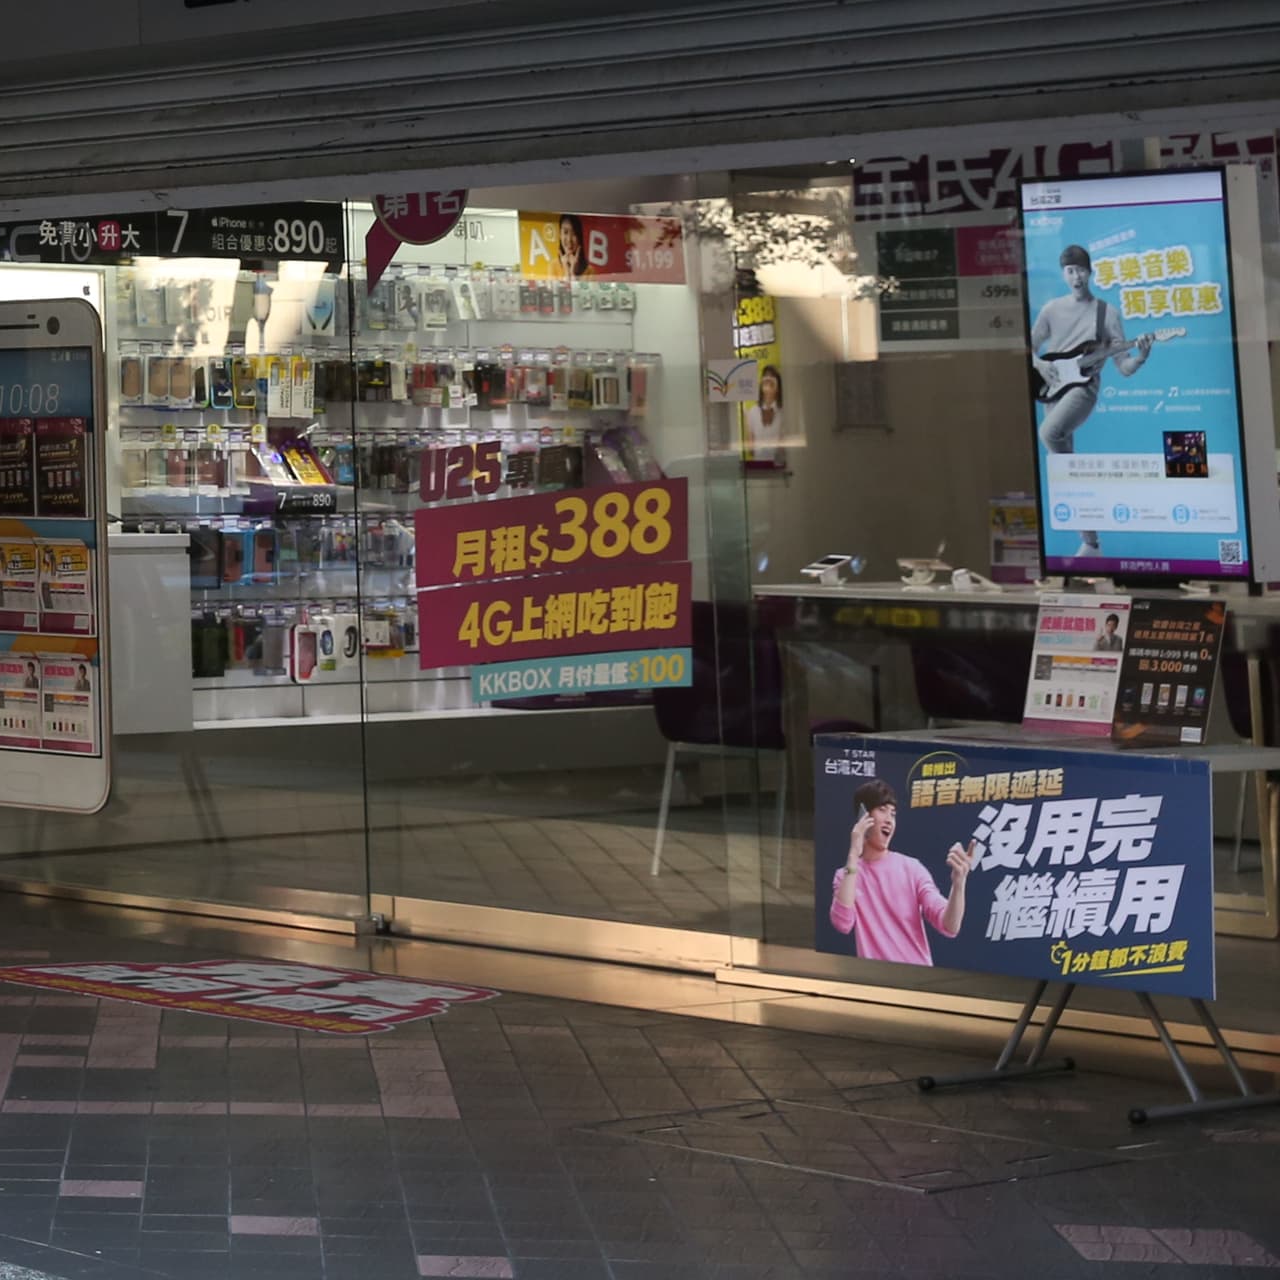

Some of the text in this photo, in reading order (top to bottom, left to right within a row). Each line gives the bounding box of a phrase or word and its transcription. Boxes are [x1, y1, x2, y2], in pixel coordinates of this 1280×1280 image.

[39, 219, 140, 251] 免費小升大
[166, 210, 189, 253] 7
[528, 229, 550, 266] A
[588, 231, 609, 267] B
[1094, 250, 1192, 289] 享樂音樂
[1122, 286, 1222, 319] 獨享優惠
[419, 441, 501, 502] U25
[453, 487, 672, 577] 月租$388
[458, 582, 679, 649] 4G上網吃到飽
[479, 654, 685, 696] KKBOX 月付最低$100
[852, 750, 875, 759] STAR
[910, 768, 1064, 809] 語音無限遞延
[969, 794, 1163, 871] 沒用完
[985, 865, 1185, 941] 繼續用
